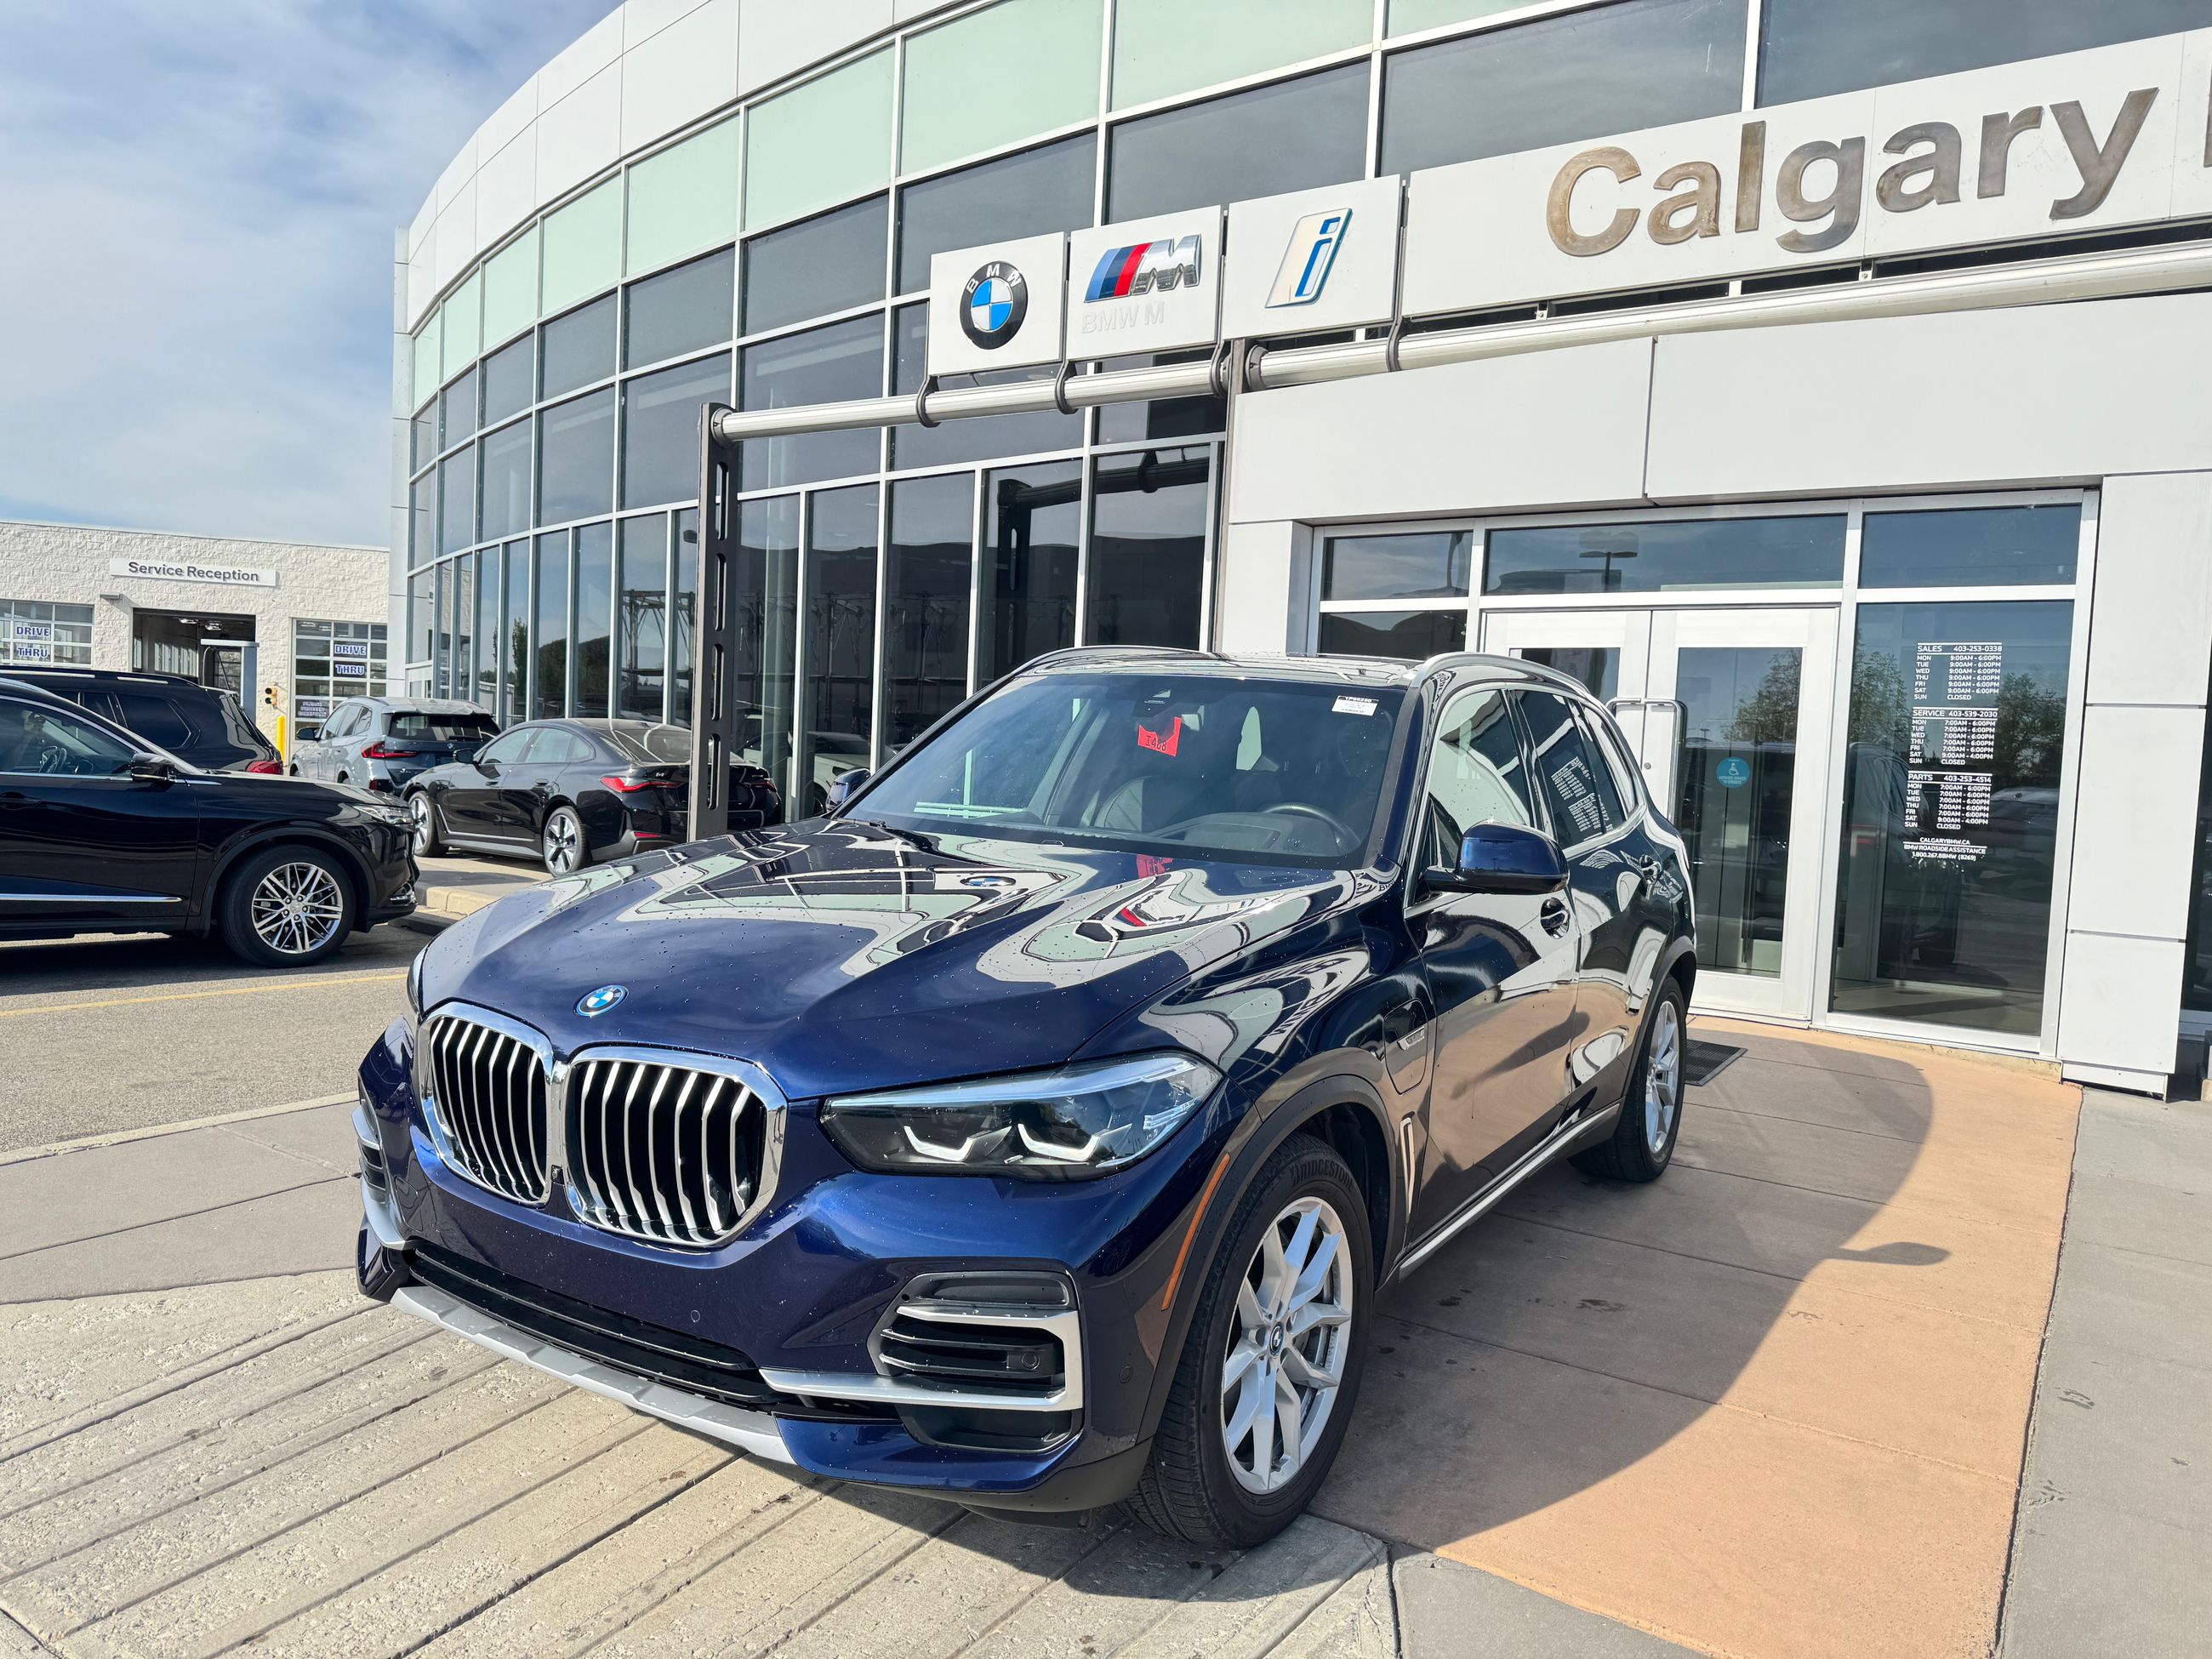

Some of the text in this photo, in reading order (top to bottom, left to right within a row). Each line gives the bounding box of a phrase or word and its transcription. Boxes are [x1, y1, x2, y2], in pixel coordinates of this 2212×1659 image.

[1546, 87, 2159, 257] Calgary
[966, 264, 1022, 294] BMW
[1082, 302, 1165, 334] BMW M
[128, 561, 259, 583] Service Reception
[15, 625, 51, 637] DRIVE
[17, 647, 49, 659] THRU
[334, 644, 367, 656] DRIVE
[334, 664, 366, 676] THRU
